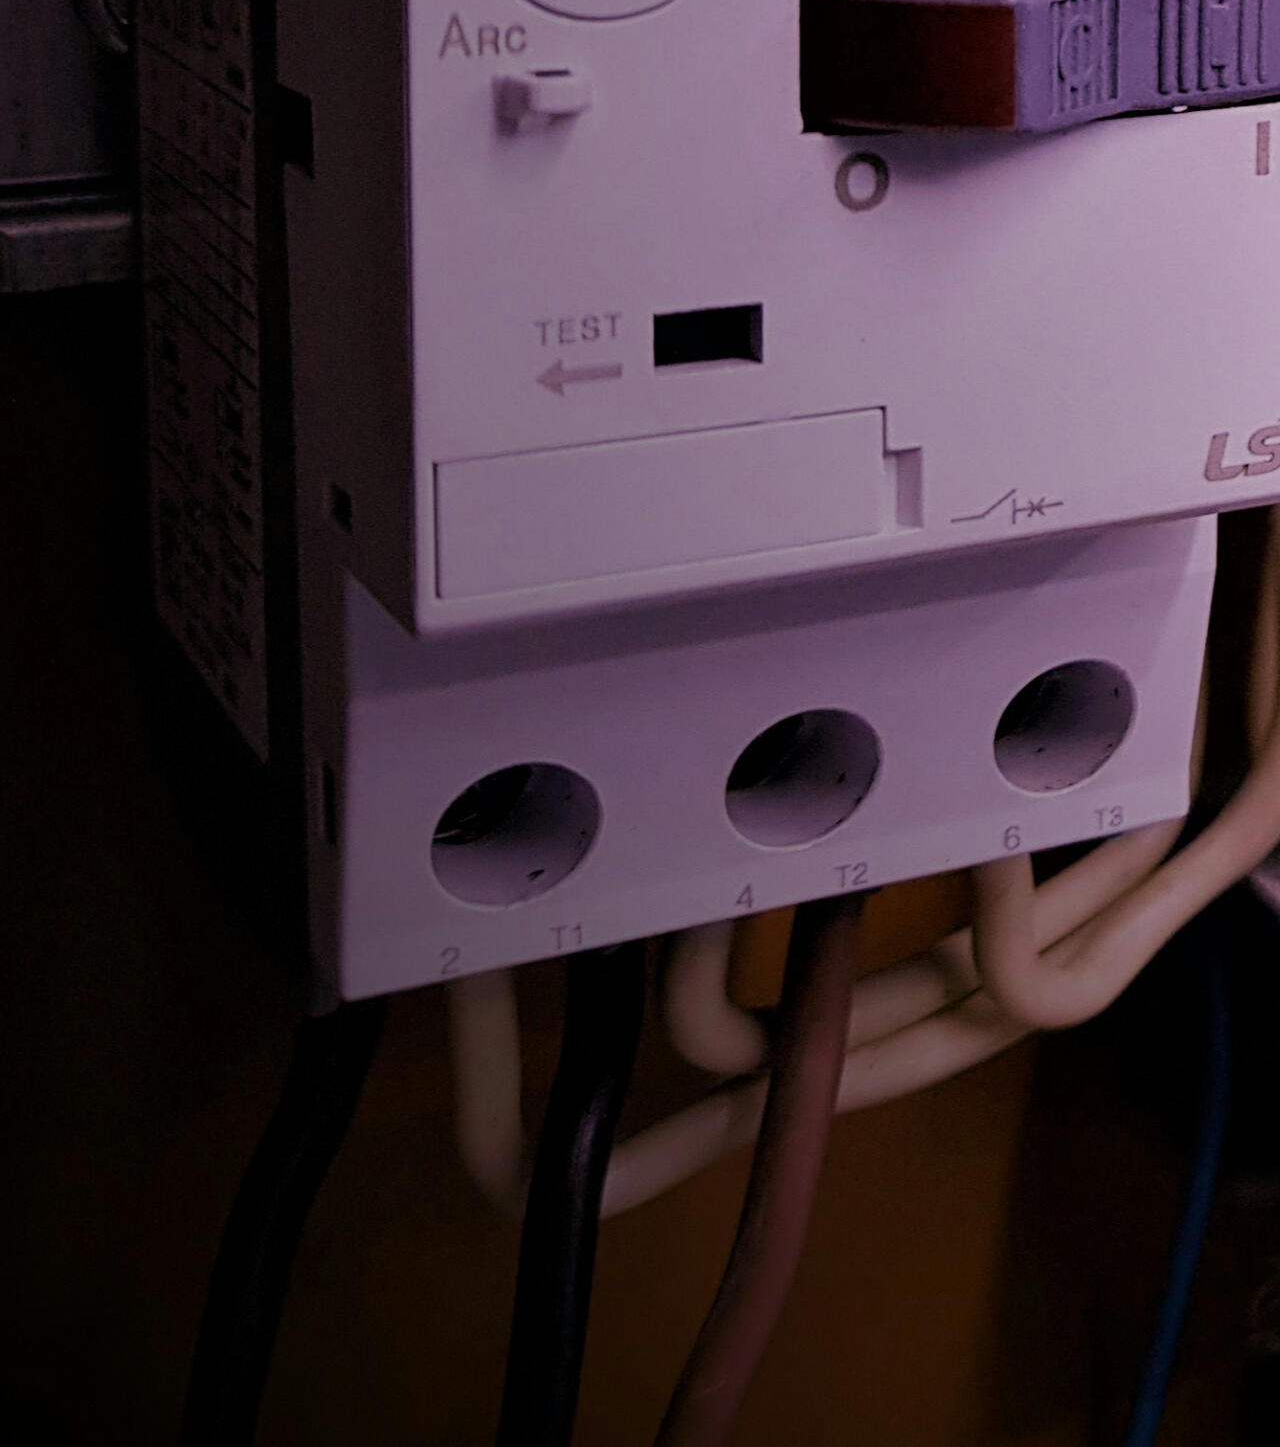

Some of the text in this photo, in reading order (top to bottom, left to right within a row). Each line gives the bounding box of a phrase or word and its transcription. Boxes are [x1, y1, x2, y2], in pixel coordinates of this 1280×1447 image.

[534, 312, 623, 347] TEST
[1094, 805, 1124, 830] T3
[1003, 824, 1022, 850] 6
[834, 861, 869, 889] T2
[735, 883, 755, 909] 4
[549, 922, 583, 950] T1
[439, 946, 461, 975] 2
